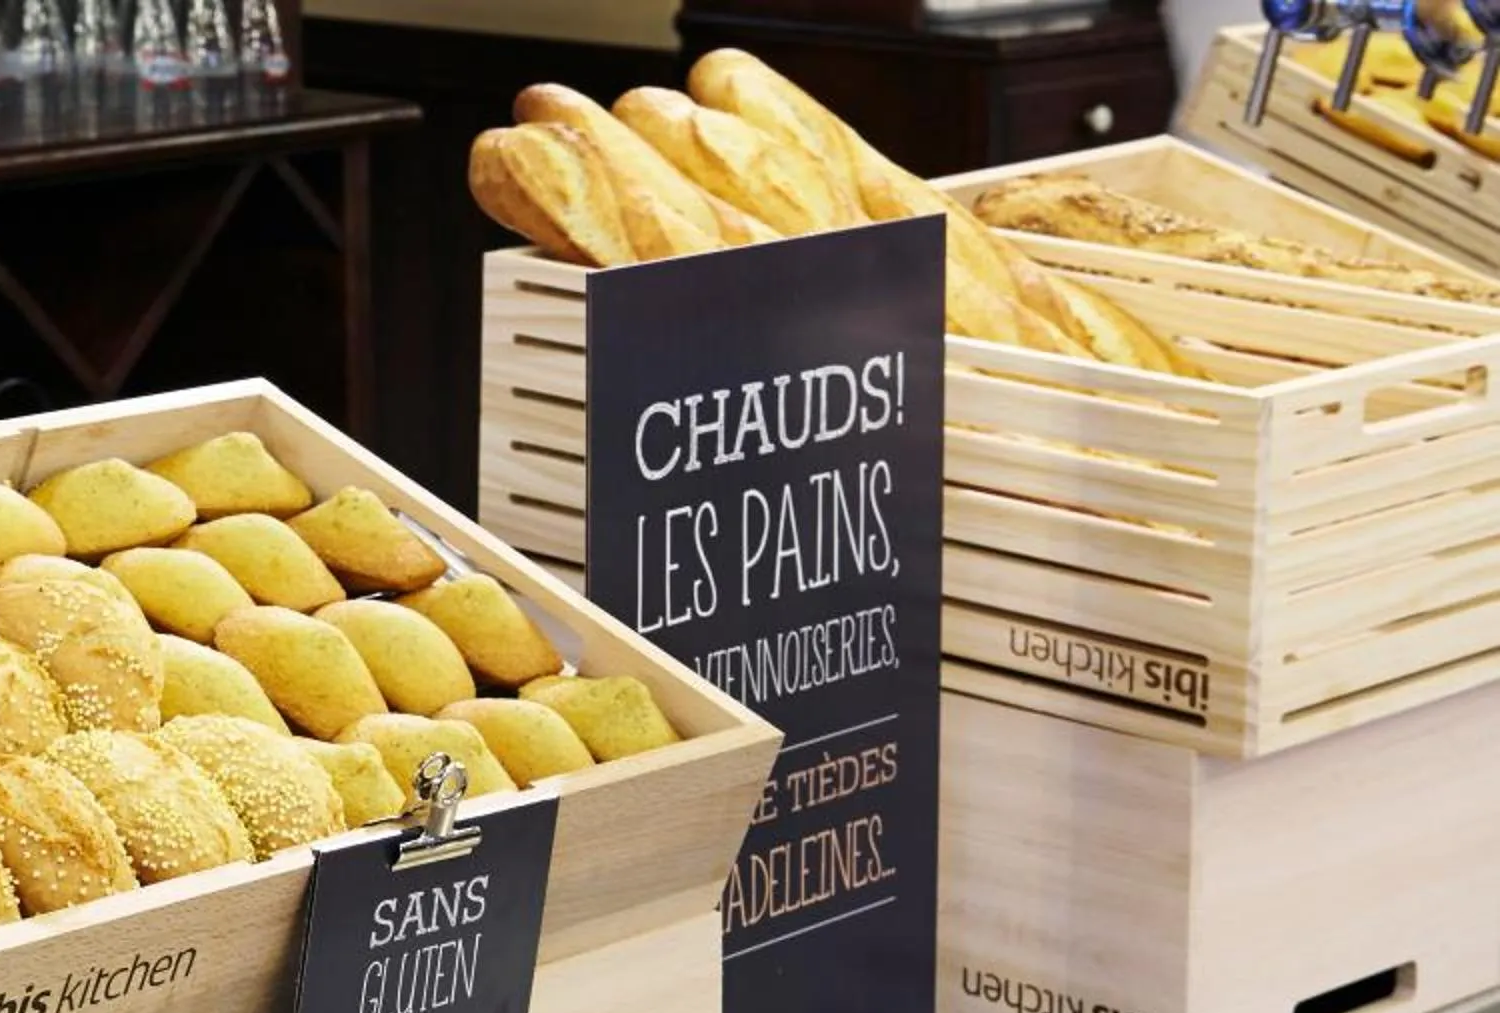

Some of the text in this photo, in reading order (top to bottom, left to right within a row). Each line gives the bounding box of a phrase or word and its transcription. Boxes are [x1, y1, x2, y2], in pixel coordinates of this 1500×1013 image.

[635, 351, 905, 481] CHAUDS!
[636, 460, 900, 634] LES PAINS,
[1009, 627, 1210, 711] ibis kitchen
[787, 742, 898, 813] TIÈDES
[369, 874, 490, 949] SANS
[723, 813, 896, 933] ADELEINES...
